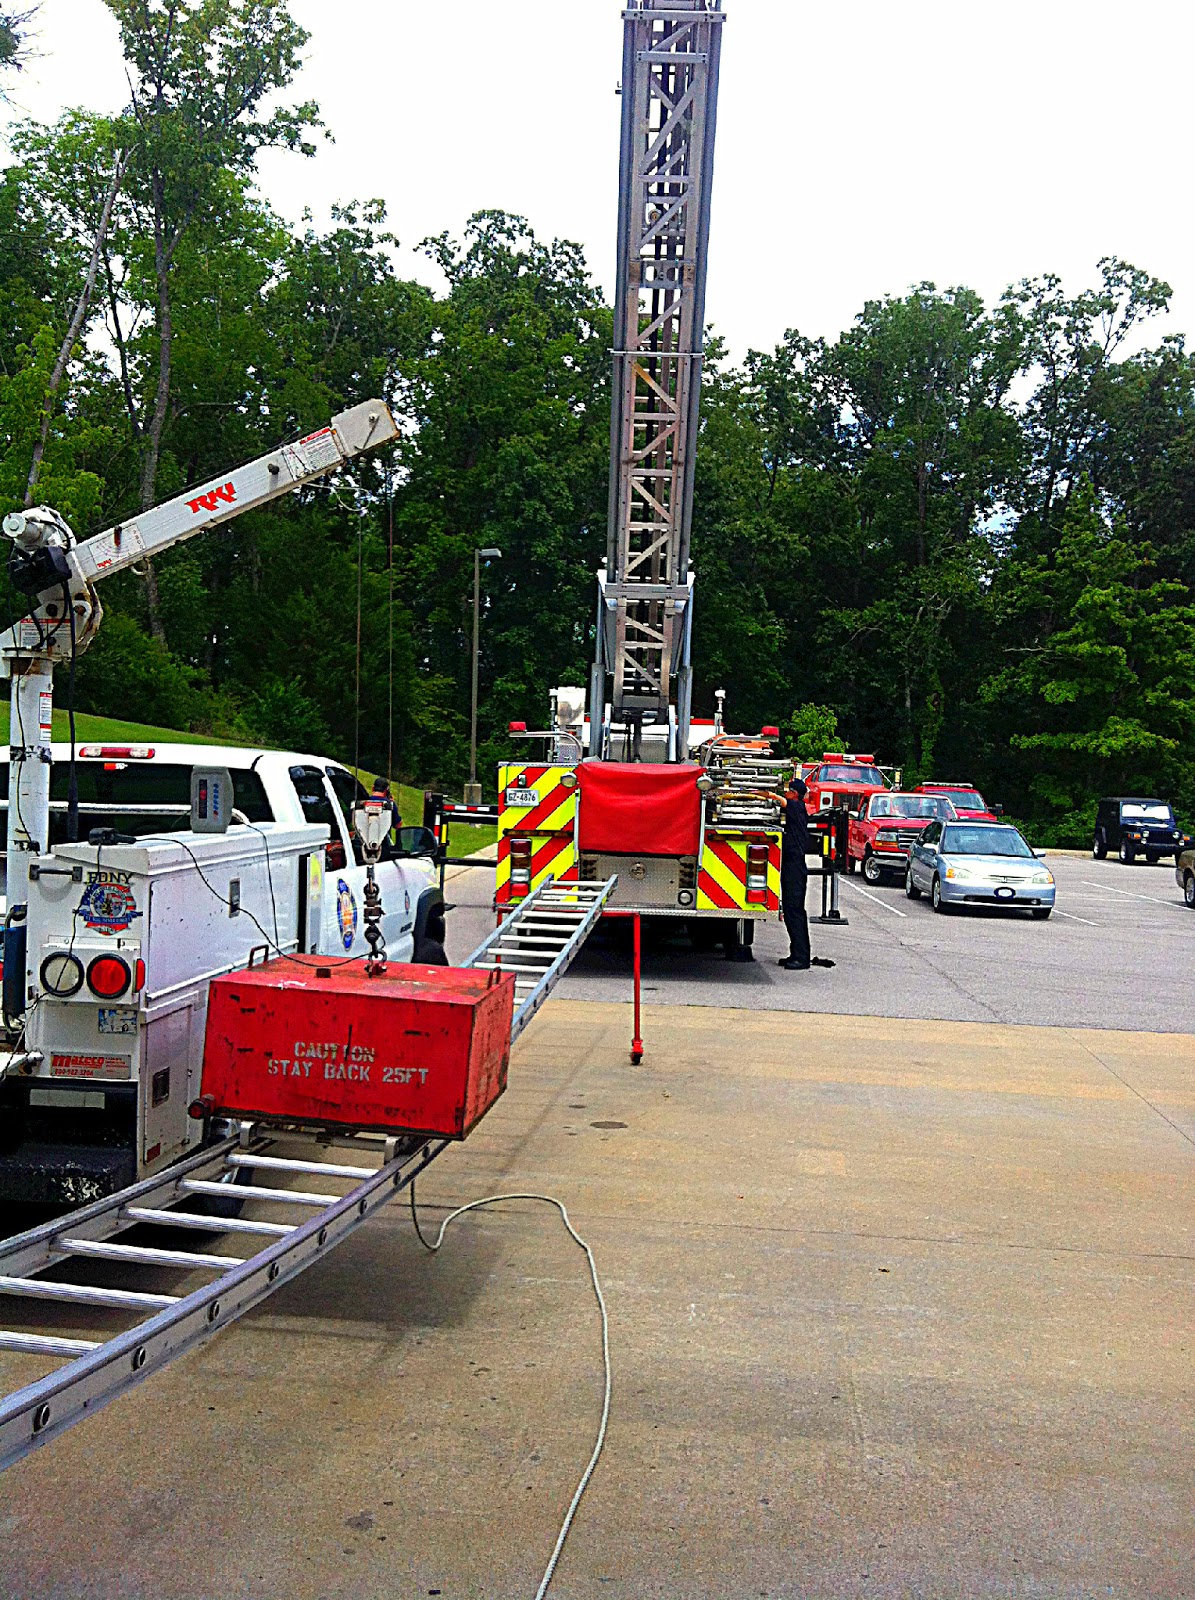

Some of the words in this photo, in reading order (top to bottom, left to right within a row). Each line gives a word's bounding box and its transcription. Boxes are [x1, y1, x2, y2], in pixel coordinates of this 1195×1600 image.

[184, 481, 237, 514] RKI
[86, 870, 134, 884] FDNY
[294, 1041, 375, 1063] CAUTION
[268, 1058, 313, 1078] STAY
[324, 1062, 371, 1082] BACK
[382, 1066, 429, 1085] 25FT
